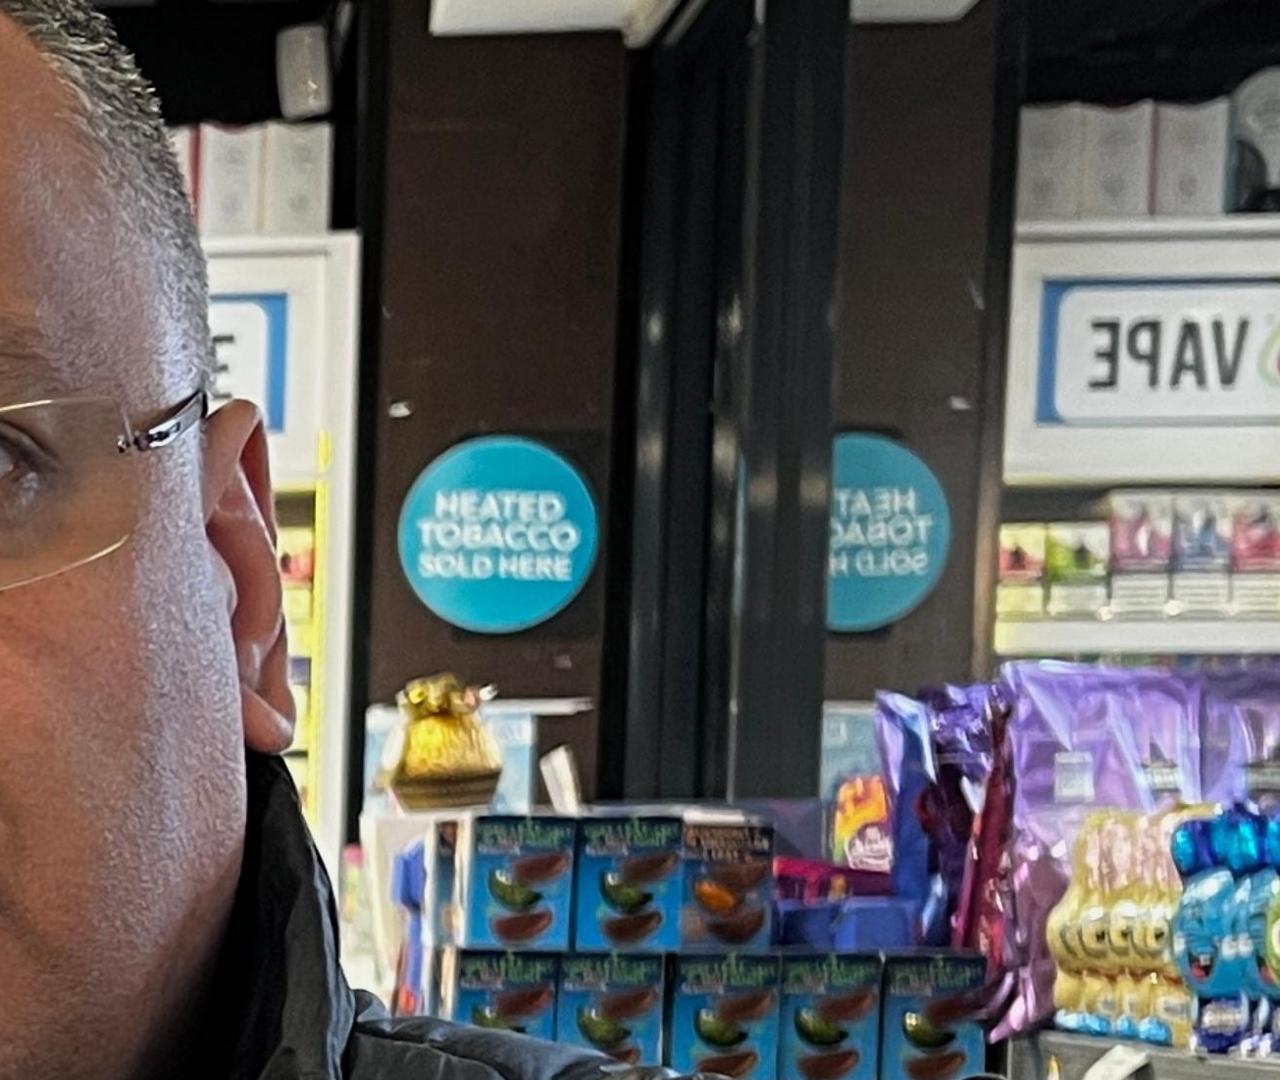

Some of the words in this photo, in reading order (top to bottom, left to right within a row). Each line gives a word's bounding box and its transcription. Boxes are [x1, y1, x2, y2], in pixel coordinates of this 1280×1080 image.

[435, 490, 565, 522] HEATED
[418, 519, 580, 551] TOBACCO
[418, 551, 494, 579] SOLD
[498, 552, 572, 581] HERE
